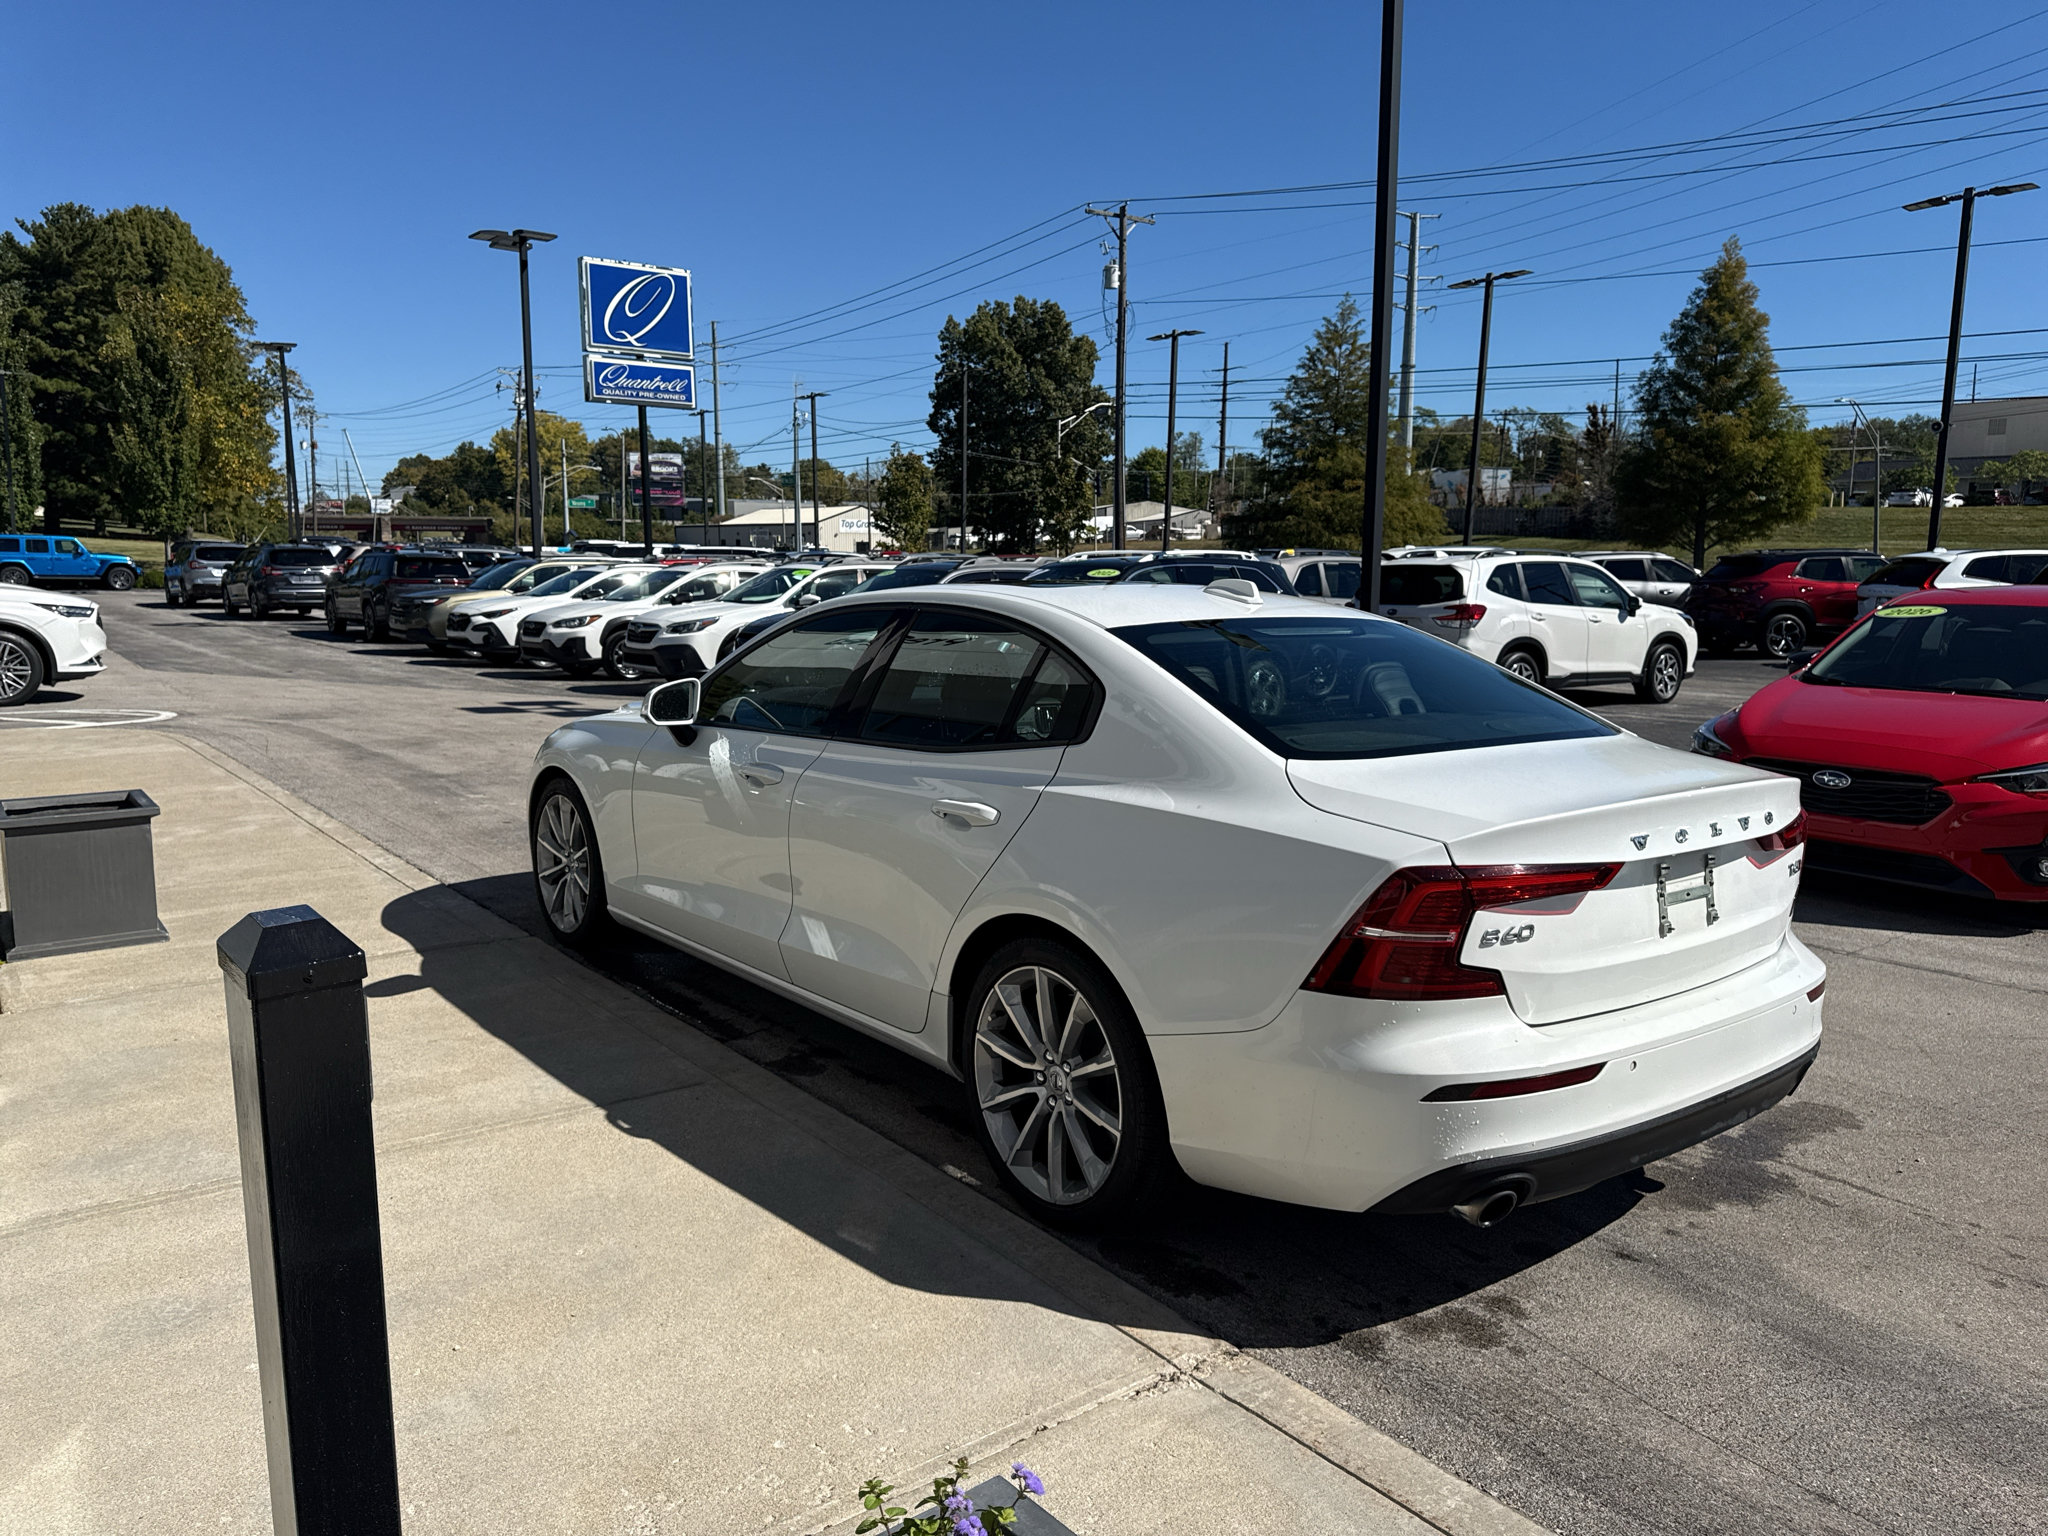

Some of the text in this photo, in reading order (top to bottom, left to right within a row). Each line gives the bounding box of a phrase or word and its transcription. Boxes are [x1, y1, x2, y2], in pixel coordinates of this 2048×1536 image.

[604, 273, 675, 346] Q
[599, 364, 688, 392] Quantrell
[602, 388, 686, 400] QUALITY PRE-OWNED
[841, 519, 855, 530] Top
[1630, 811, 1774, 851] VOLVO
[1479, 924, 1535, 949] S60
